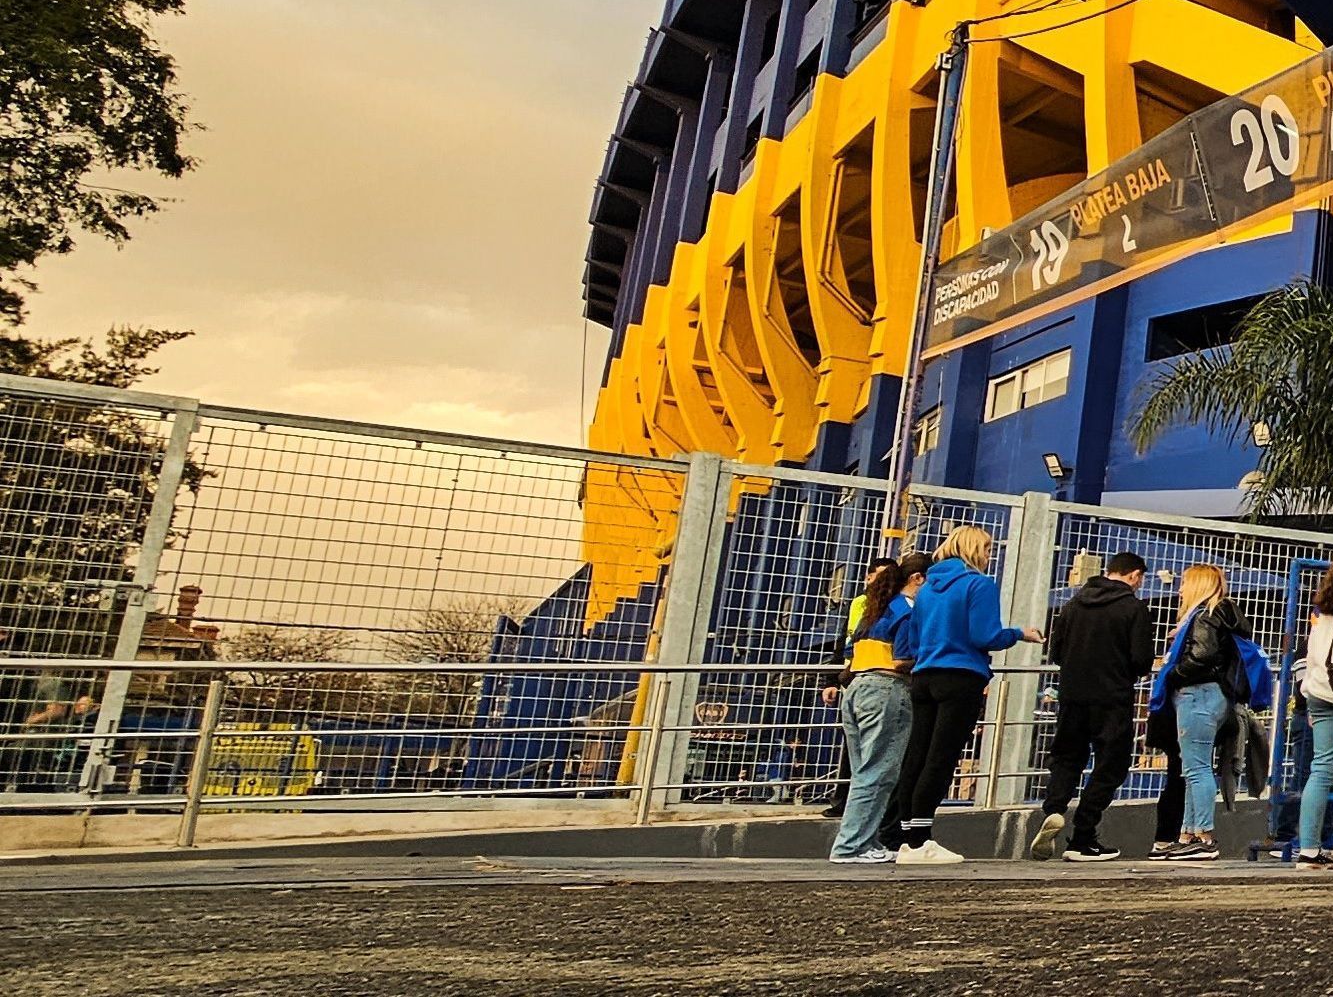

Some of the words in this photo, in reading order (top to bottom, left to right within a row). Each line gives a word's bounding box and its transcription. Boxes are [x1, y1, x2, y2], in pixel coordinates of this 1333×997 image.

[1230, 94, 1299, 192] 20
[1070, 182, 1128, 230] PLATEA
[1125, 159, 1171, 201] BAJA
[935, 269, 984, 305] PERSONAS
[981, 258, 1010, 280] CON
[1030, 221, 1069, 291] 19
[933, 280, 999, 325] DISCAPACIDAD
